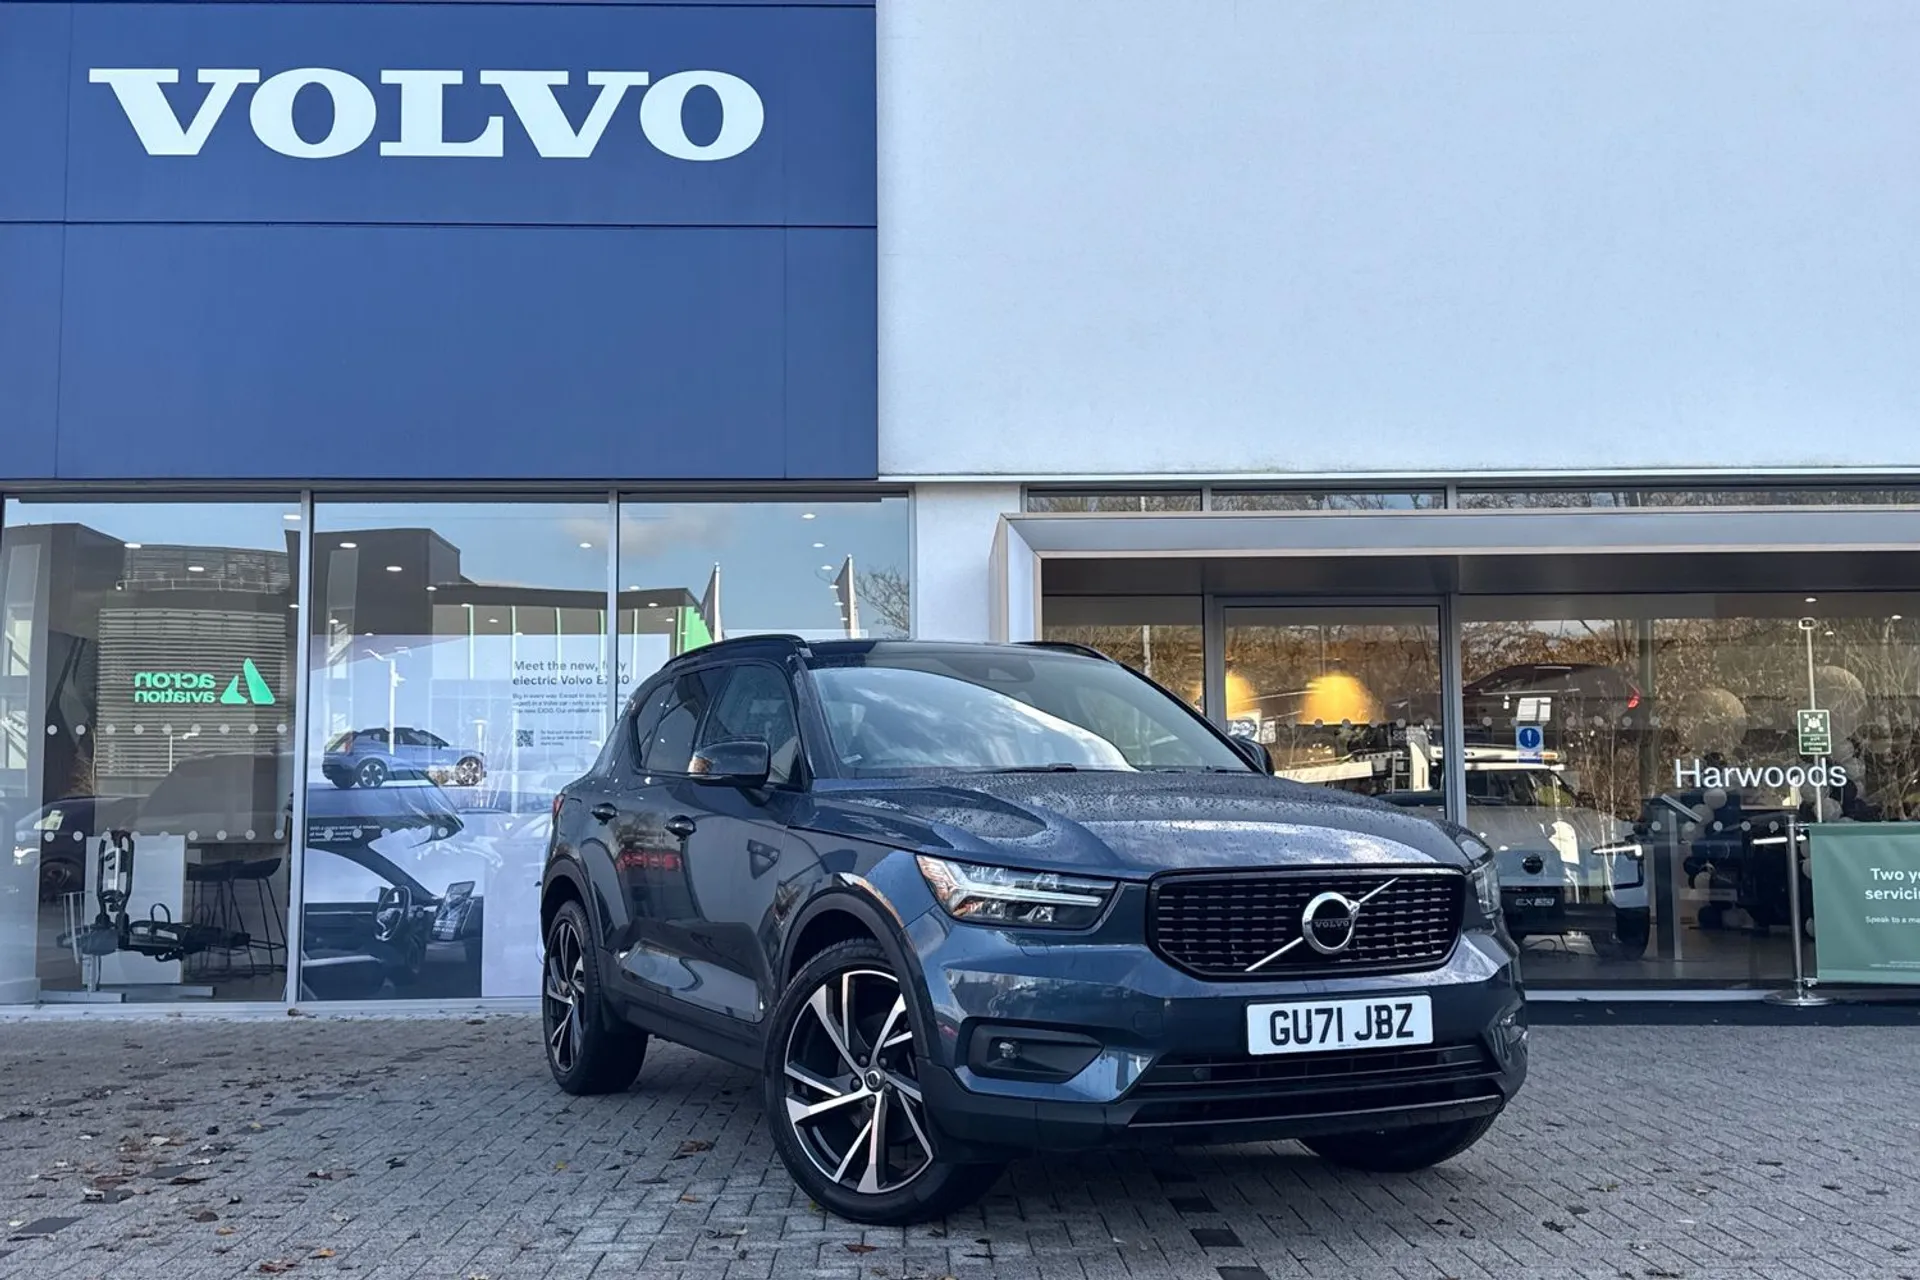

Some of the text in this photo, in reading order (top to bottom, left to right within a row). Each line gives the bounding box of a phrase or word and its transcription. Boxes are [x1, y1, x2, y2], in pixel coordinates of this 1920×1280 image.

[89, 67, 764, 161] VOLVO
[514, 660, 544, 671] Meet
[547, 660, 567, 671] the
[570, 662, 598, 672] new,
[512, 675, 557, 685] electric
[560, 675, 593, 685] Volvo
[1675, 757, 1848, 788] Harwoods
[1870, 868, 1904, 881] Two
[1865, 887, 1920, 900] servici
[1314, 920, 1350, 928] VOLVO
[1270, 1003, 1415, 1046] GU71 JBZ
